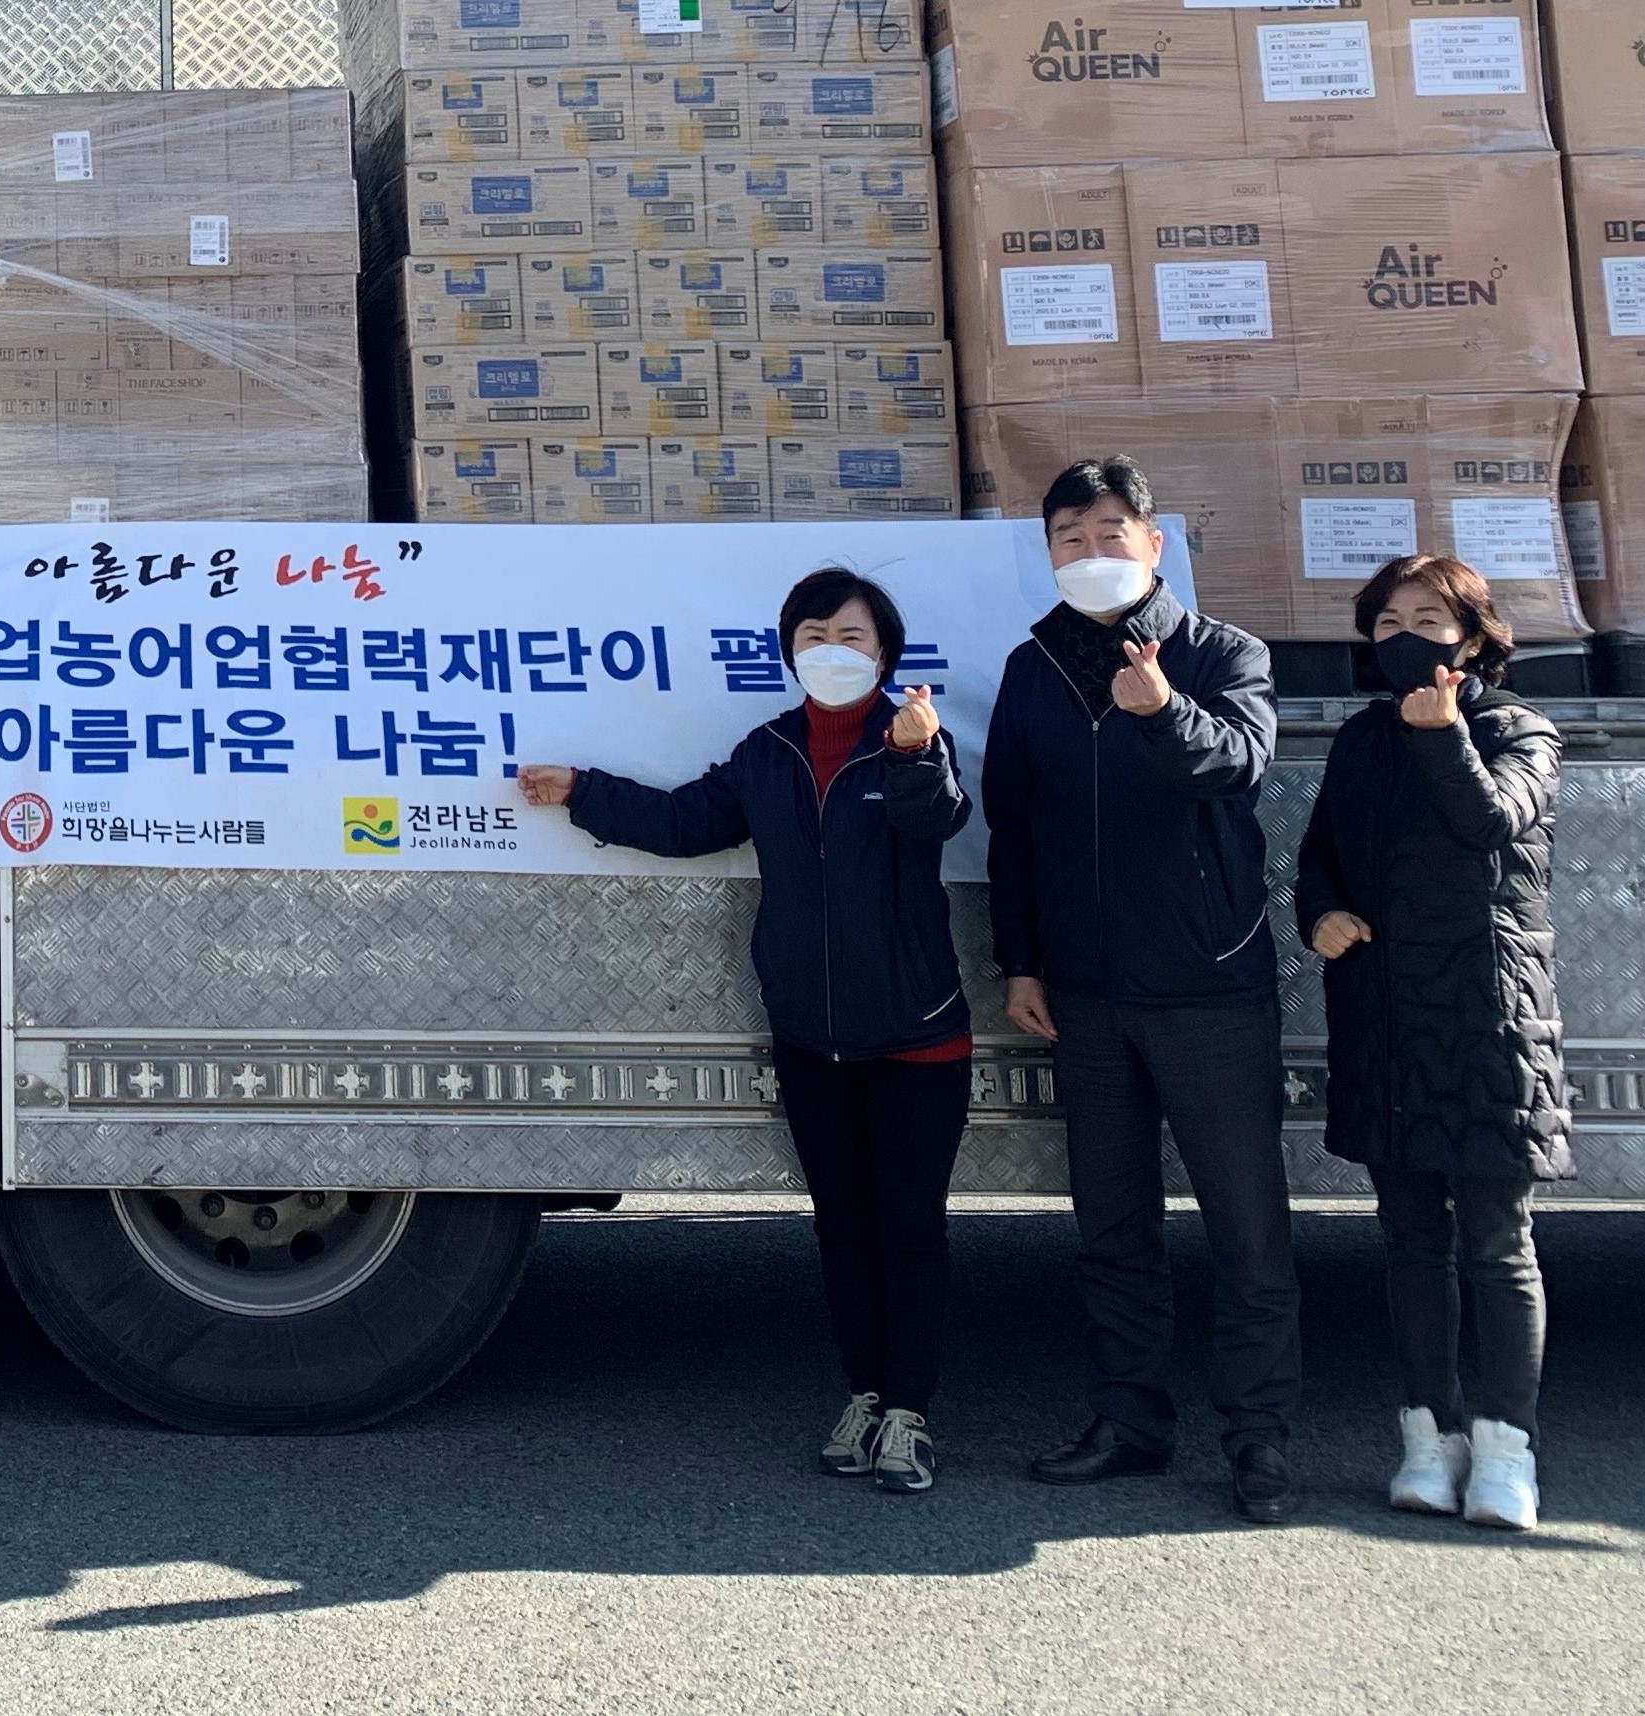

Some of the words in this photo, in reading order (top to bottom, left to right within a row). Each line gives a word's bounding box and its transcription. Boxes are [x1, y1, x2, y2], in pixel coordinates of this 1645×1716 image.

[1041, 17, 1107, 52] Air
[1032, 53, 1160, 82] QUEEN
[1323, 88, 1370, 97] TOPTEC
[1374, 242, 1443, 280] Air
[1367, 280, 1497, 310] QUEEN
[25, 541, 240, 604] 아름다운
[710, 627, 949, 696] 펼는
[335, 709, 520, 779] 나눔!
[62, 800, 112, 813] 사단법인
[407, 804, 518, 832] 전라남도
[61, 816, 266, 845] 희망을나누는사람들
[410, 836, 518, 851] JeollaNamdo
